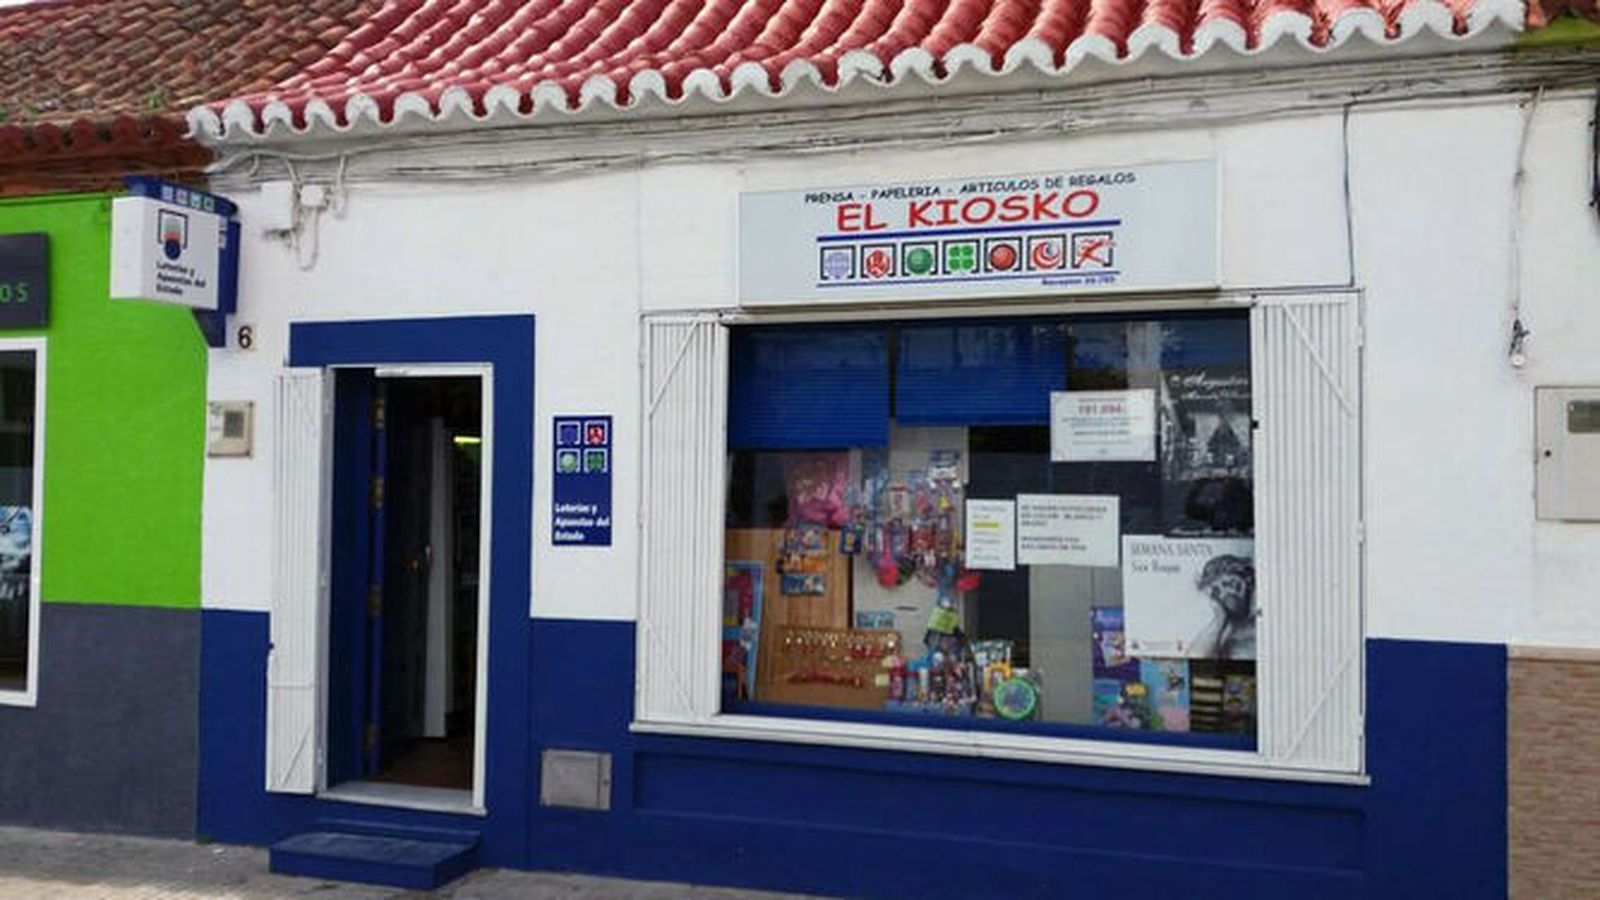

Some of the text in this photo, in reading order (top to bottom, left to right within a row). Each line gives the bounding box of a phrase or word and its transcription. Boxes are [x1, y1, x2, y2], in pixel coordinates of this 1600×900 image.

[804, 191, 854, 204] PRENSA
[871, 186, 941, 200] PAPELERIA
[959, 179, 1040, 194] ARTICULOS
[1045, 175, 1063, 188] DE
[1069, 171, 1136, 187] REGALOS
[837, 188, 1099, 231] EL KIOSKO
[237, 325, 253, 349] 6
